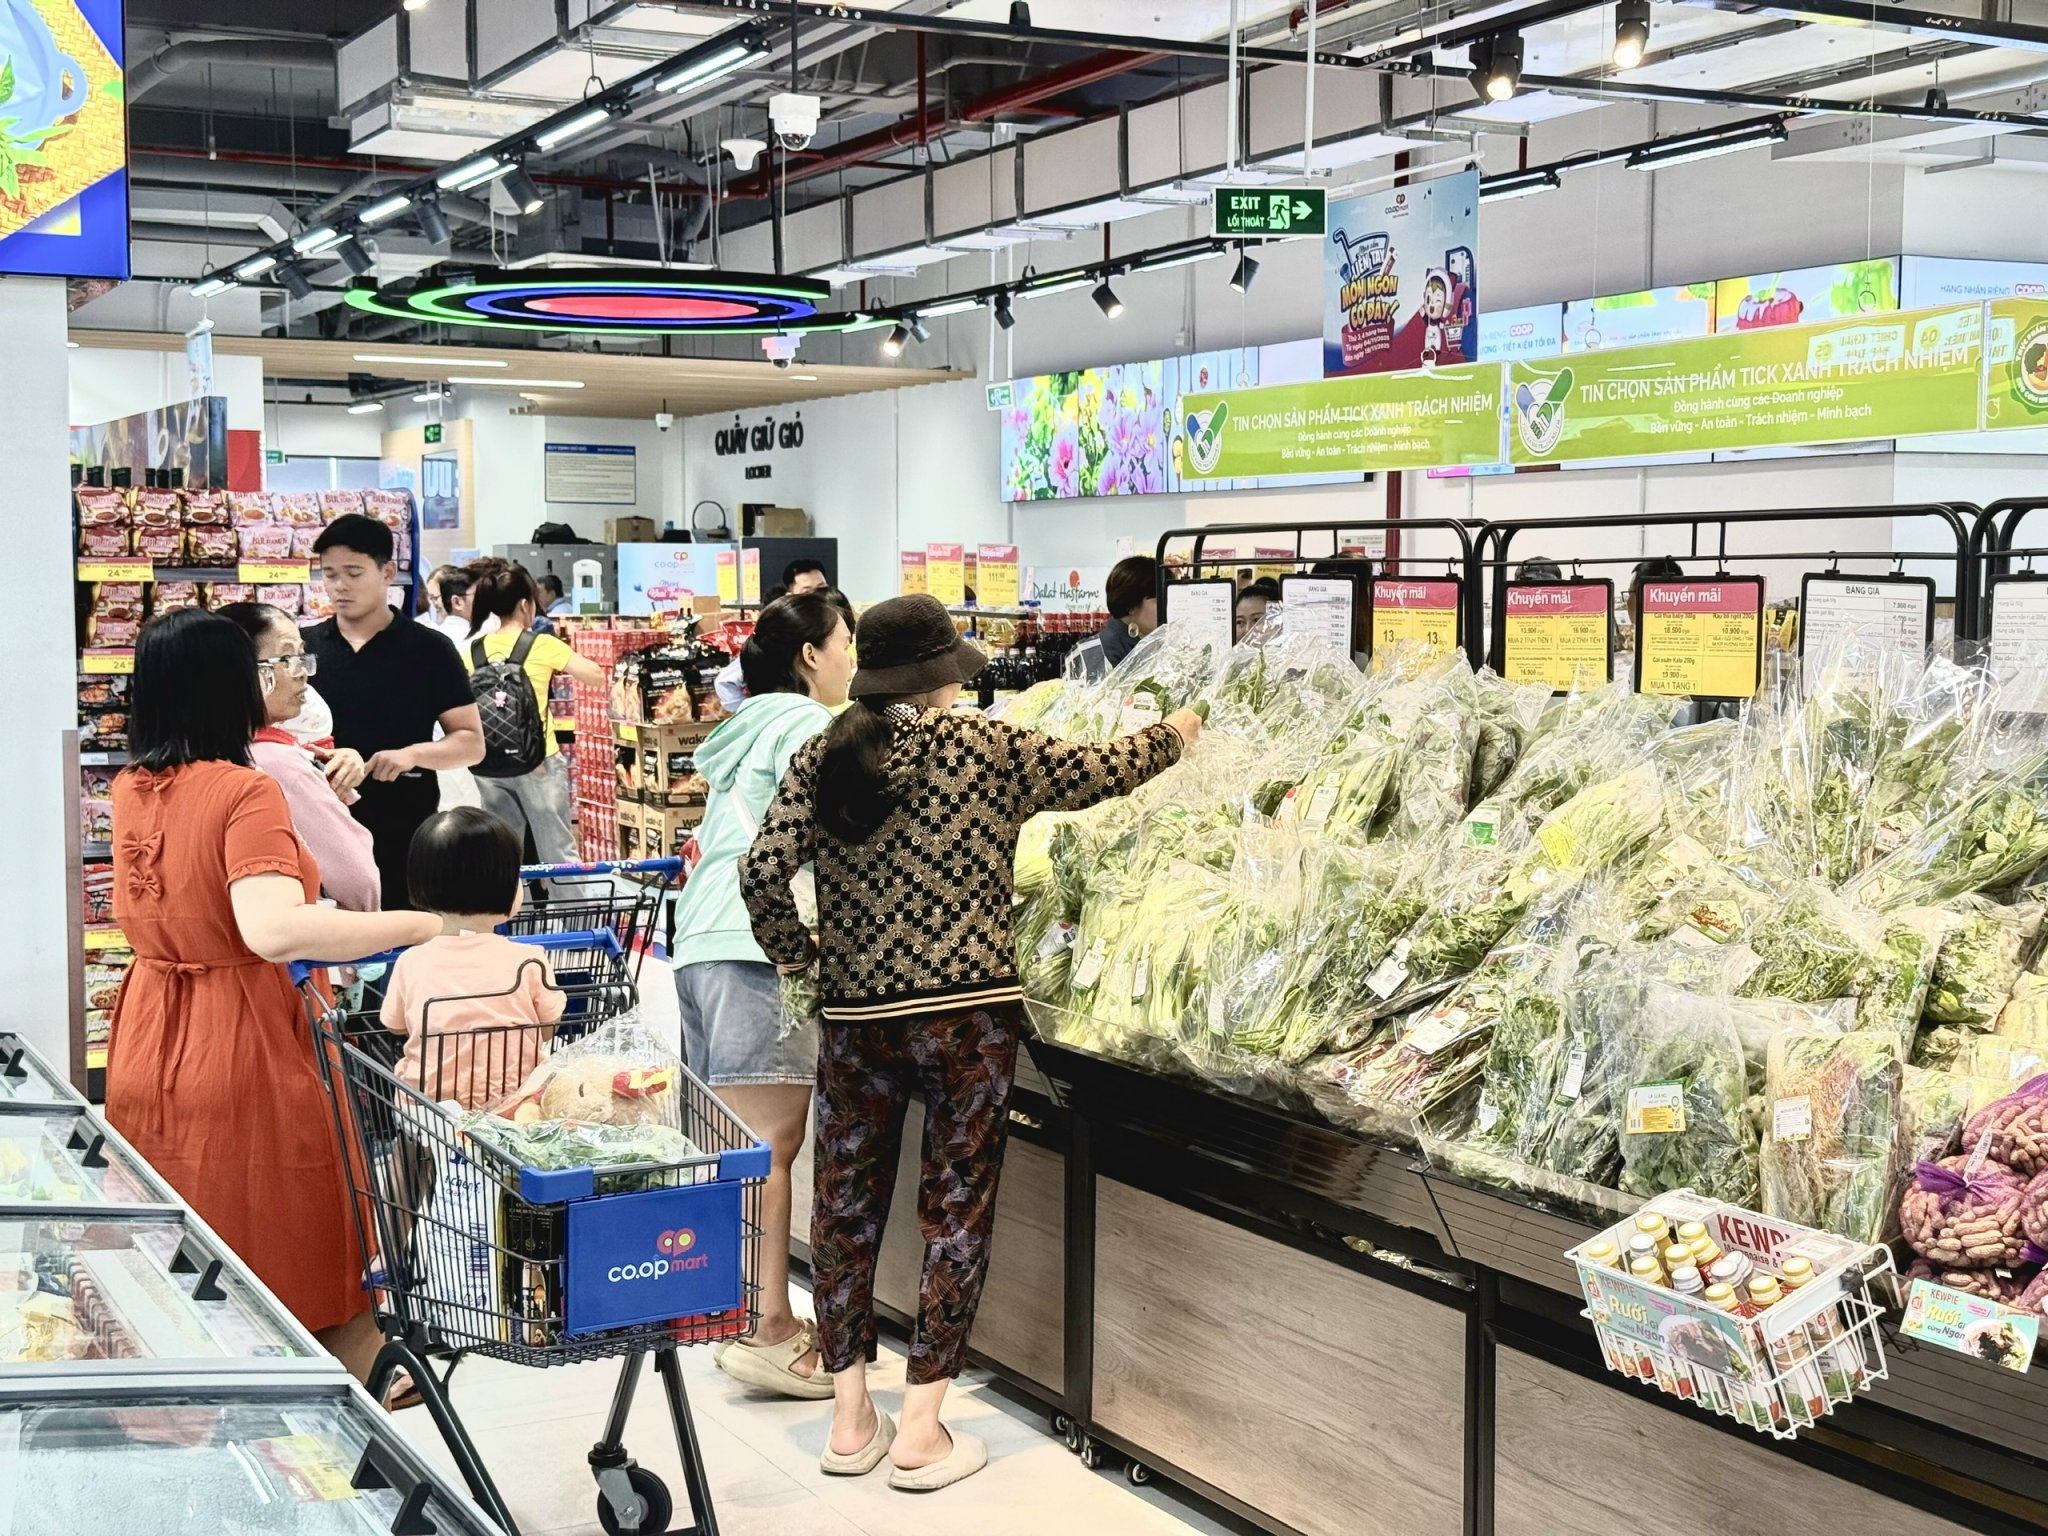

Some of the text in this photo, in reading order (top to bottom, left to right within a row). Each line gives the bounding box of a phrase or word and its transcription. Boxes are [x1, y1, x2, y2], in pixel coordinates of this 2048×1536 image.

[1231, 196, 1261, 210] EXIT
[1227, 213, 1265, 228] LỐI THOÁT
[1366, 275, 1398, 299] NGON
[1510, 323, 1534, 337] COOP
[1579, 384, 1604, 404] TIN
[1606, 379, 1650, 403] CHỌN
[1653, 370, 1686, 396] SẢN
[1689, 362, 1736, 393] PHẨM
[1739, 362, 1778, 386] TICK
[1781, 359, 1832, 383] XANH
[1903, 344, 1969, 372] NHIỆM
[1673, 386, 1844, 415] Đồng hành cùng các Doanh nghiệp
[1232, 415, 1250, 433] TIN
[1251, 412, 1282, 433] CHỌN
[1284, 406, 1306, 428] SẢN
[1342, 403, 1369, 422] TICK
[1370, 400, 1404, 422] XANH
[1407, 394, 1448, 418] TRÁCH
[1451, 390, 1493, 417] NHIỆM
[1650, 419, 1669, 435] Bền
[1669, 418, 1694, 434] vững
[1700, 418, 1714, 430] An
[1715, 415, 1738, 429] toàn
[1745, 411, 1774, 427] Trách
[1775, 405, 1808, 425] nhiệm
[1816, 406, 1843, 421] Minh
[1844, 403, 1873, 421] bạch
[778, 410, 804, 449] GIỎ
[1316, 430, 1332, 441] hành
[1387, 423, 1412, 439] nghiệp
[1295, 445, 1311, 460] vững
[1316, 447, 1325, 457] An
[1346, 443, 1366, 455] Trách
[1367, 441, 1388, 455] nhiệm
[1393, 439, 1411, 452] Minh
[1411, 438, 1430, 452] bạch
[107, 569, 120, 578] 24
[268, 571, 279, 579] 24
[1032, 581, 1057, 600] Dalat
[1374, 584, 1426, 602] Khuyến mãi
[1507, 589, 1571, 609] Khuyến mãi
[1649, 586, 1721, 607] Khuyến mãi
[1383, 629, 1395, 643] 13
[1427, 631, 1438, 645] 13
[113, 661, 126, 670] 24
[1650, 681, 1666, 689] MUA
[1599, 1273, 1638, 1299] KEWPIE
[1929, 1287, 1960, 1306] KEWPIE
[1636, 1323, 1666, 1344] Ngon
[1942, 1324, 1967, 1341] Ngon
